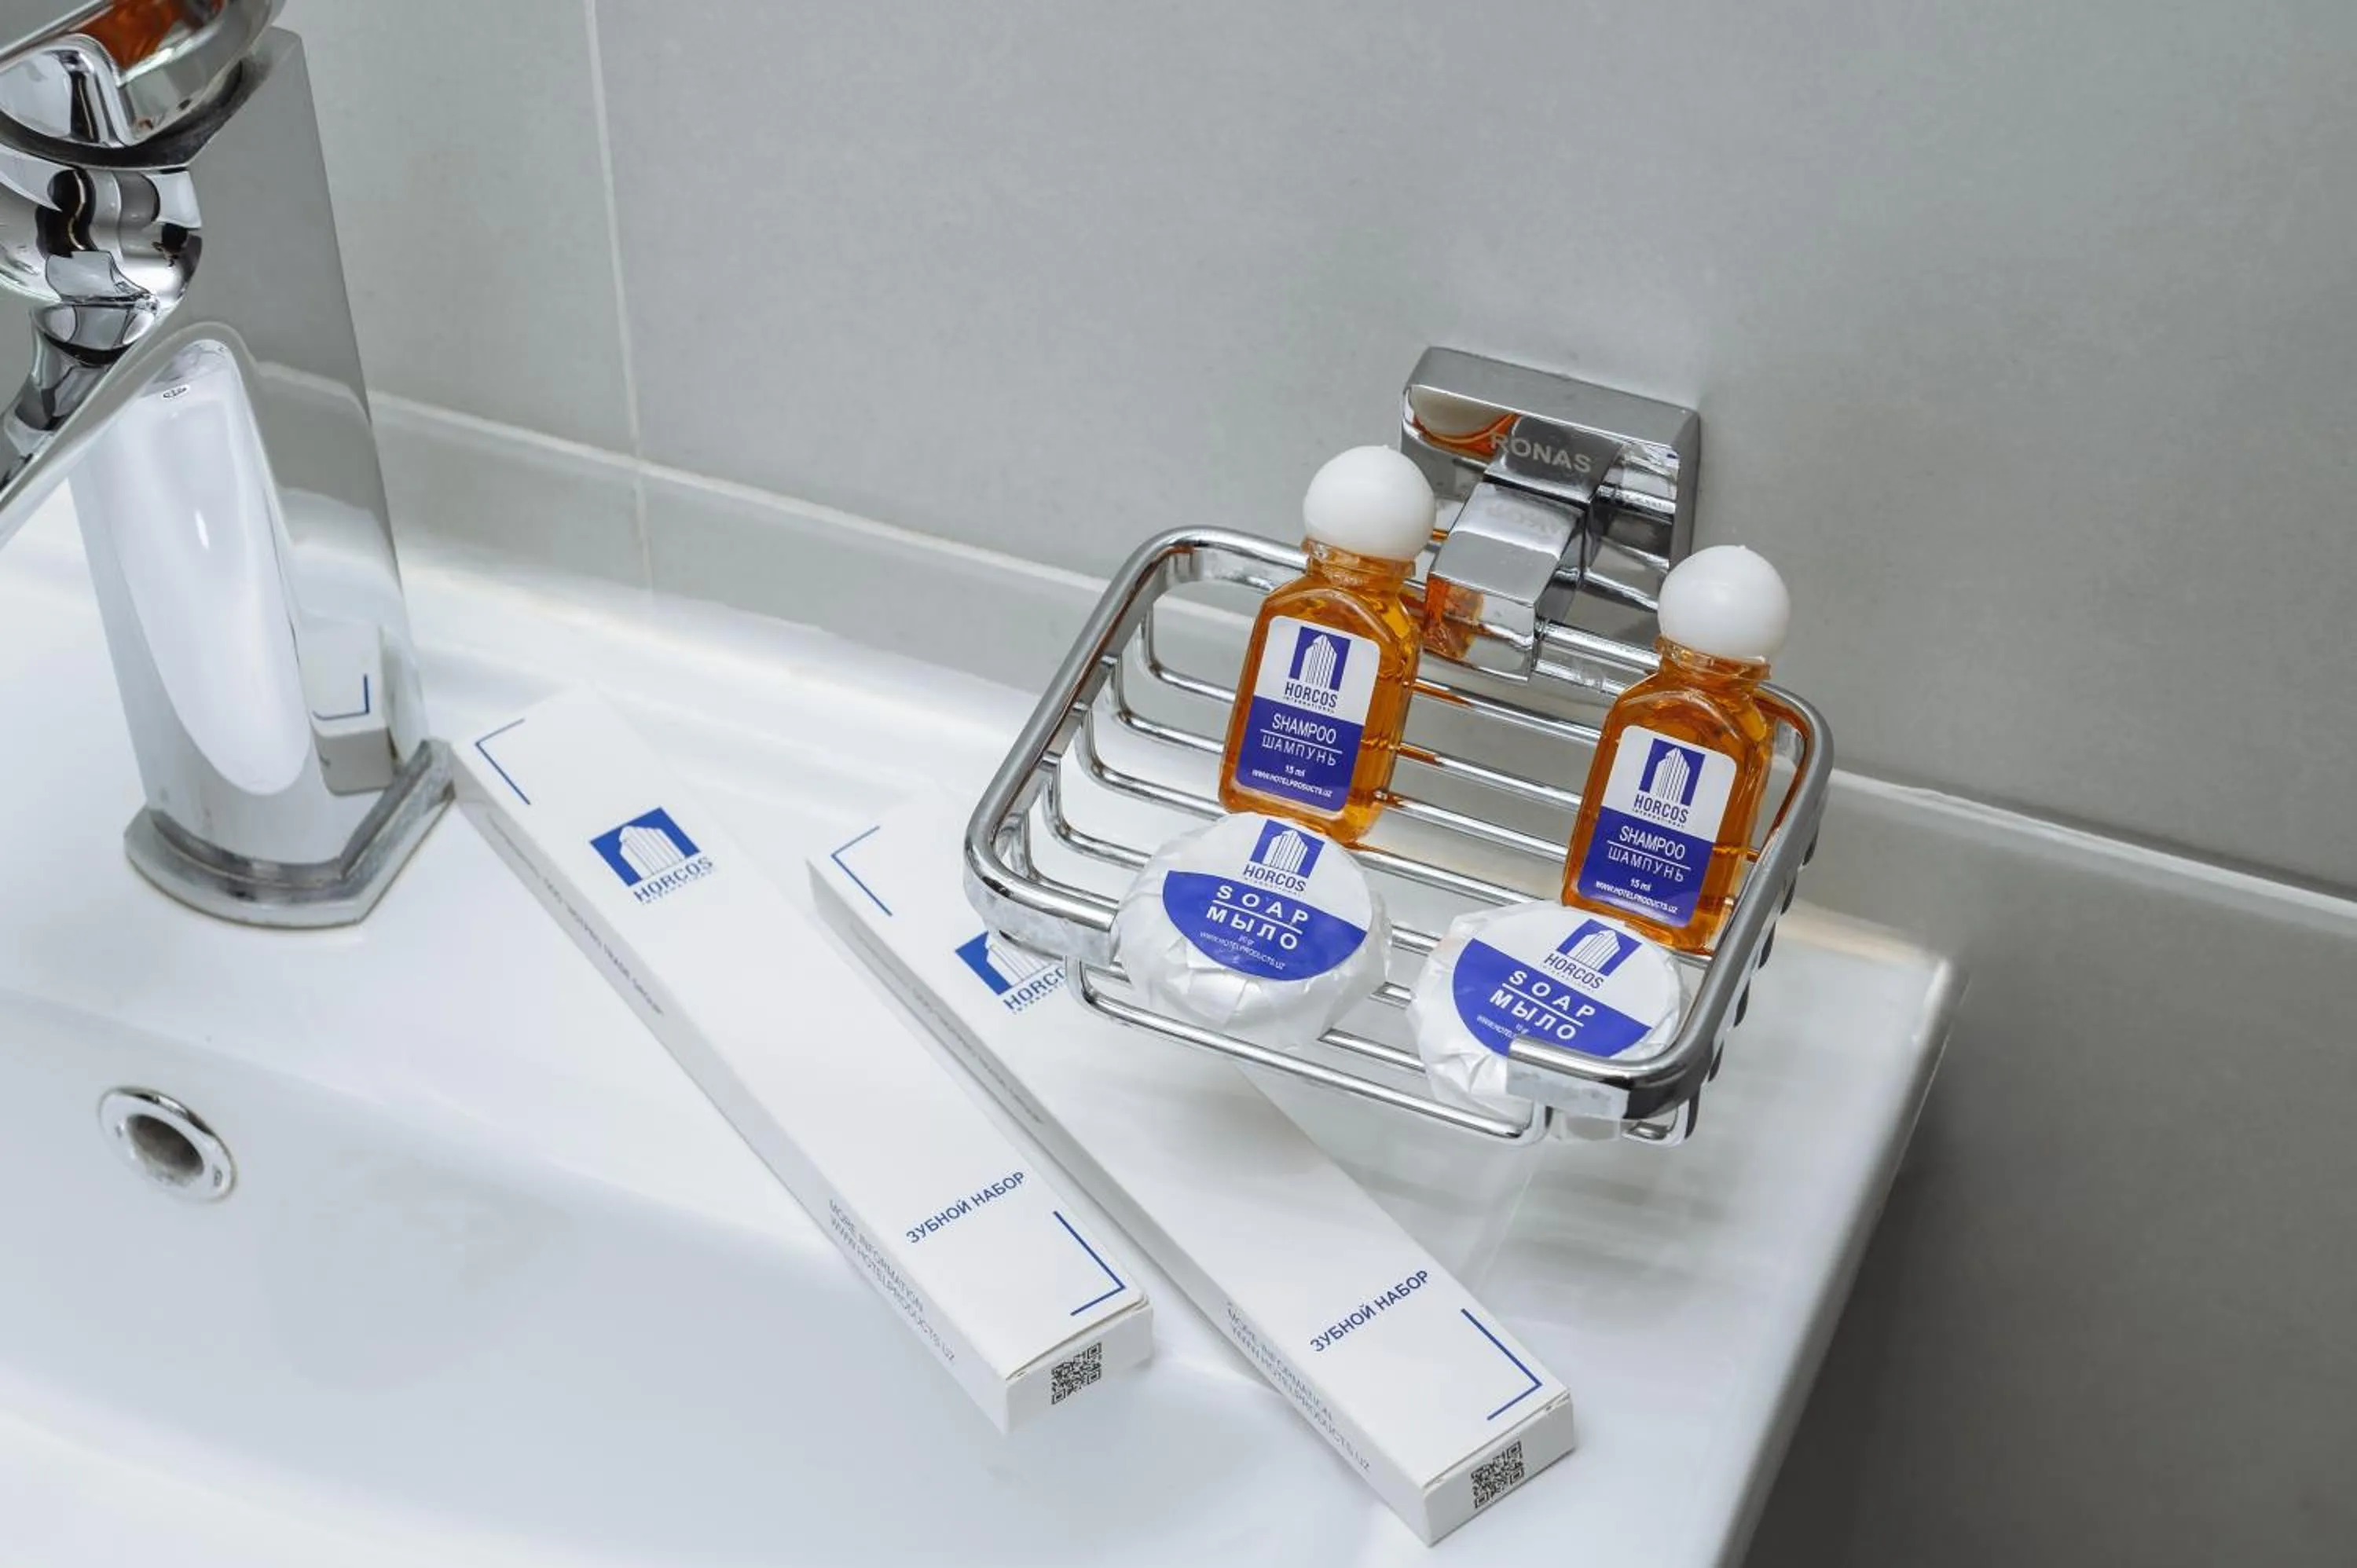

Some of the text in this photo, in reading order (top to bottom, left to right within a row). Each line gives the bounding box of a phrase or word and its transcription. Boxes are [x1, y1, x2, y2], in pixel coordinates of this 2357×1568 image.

[1490, 432, 1592, 473] RONAS
[1285, 681, 1338, 708] HORCOS
[1272, 713, 1336, 744] SHAMPOO
[1261, 735, 1336, 767] ШАМПУНЬ
[1634, 793, 1688, 824] HORCOS
[1619, 826, 1685, 860] SHAMPOO
[633, 857, 713, 902] HORCOS
[1243, 863, 1307, 892] HORCOS
[1608, 847, 1684, 882] ШАМПУНЬ
[1630, 877, 1640, 888] 15
[1215, 885, 1309, 925] SOAP
[1206, 906, 1297, 951] МЫЛО
[1003, 967, 1065, 1009] HORC
[1543, 953, 1604, 989] HORCOS
[1508, 970, 1596, 1018] SOAP
[1490, 989, 1576, 1040] МЫЛО
[906, 1171, 1025, 1244] ЗУБНОЙ НАБОР
[1310, 1270, 1428, 1352] ЗУБНОЙ НАБОР
